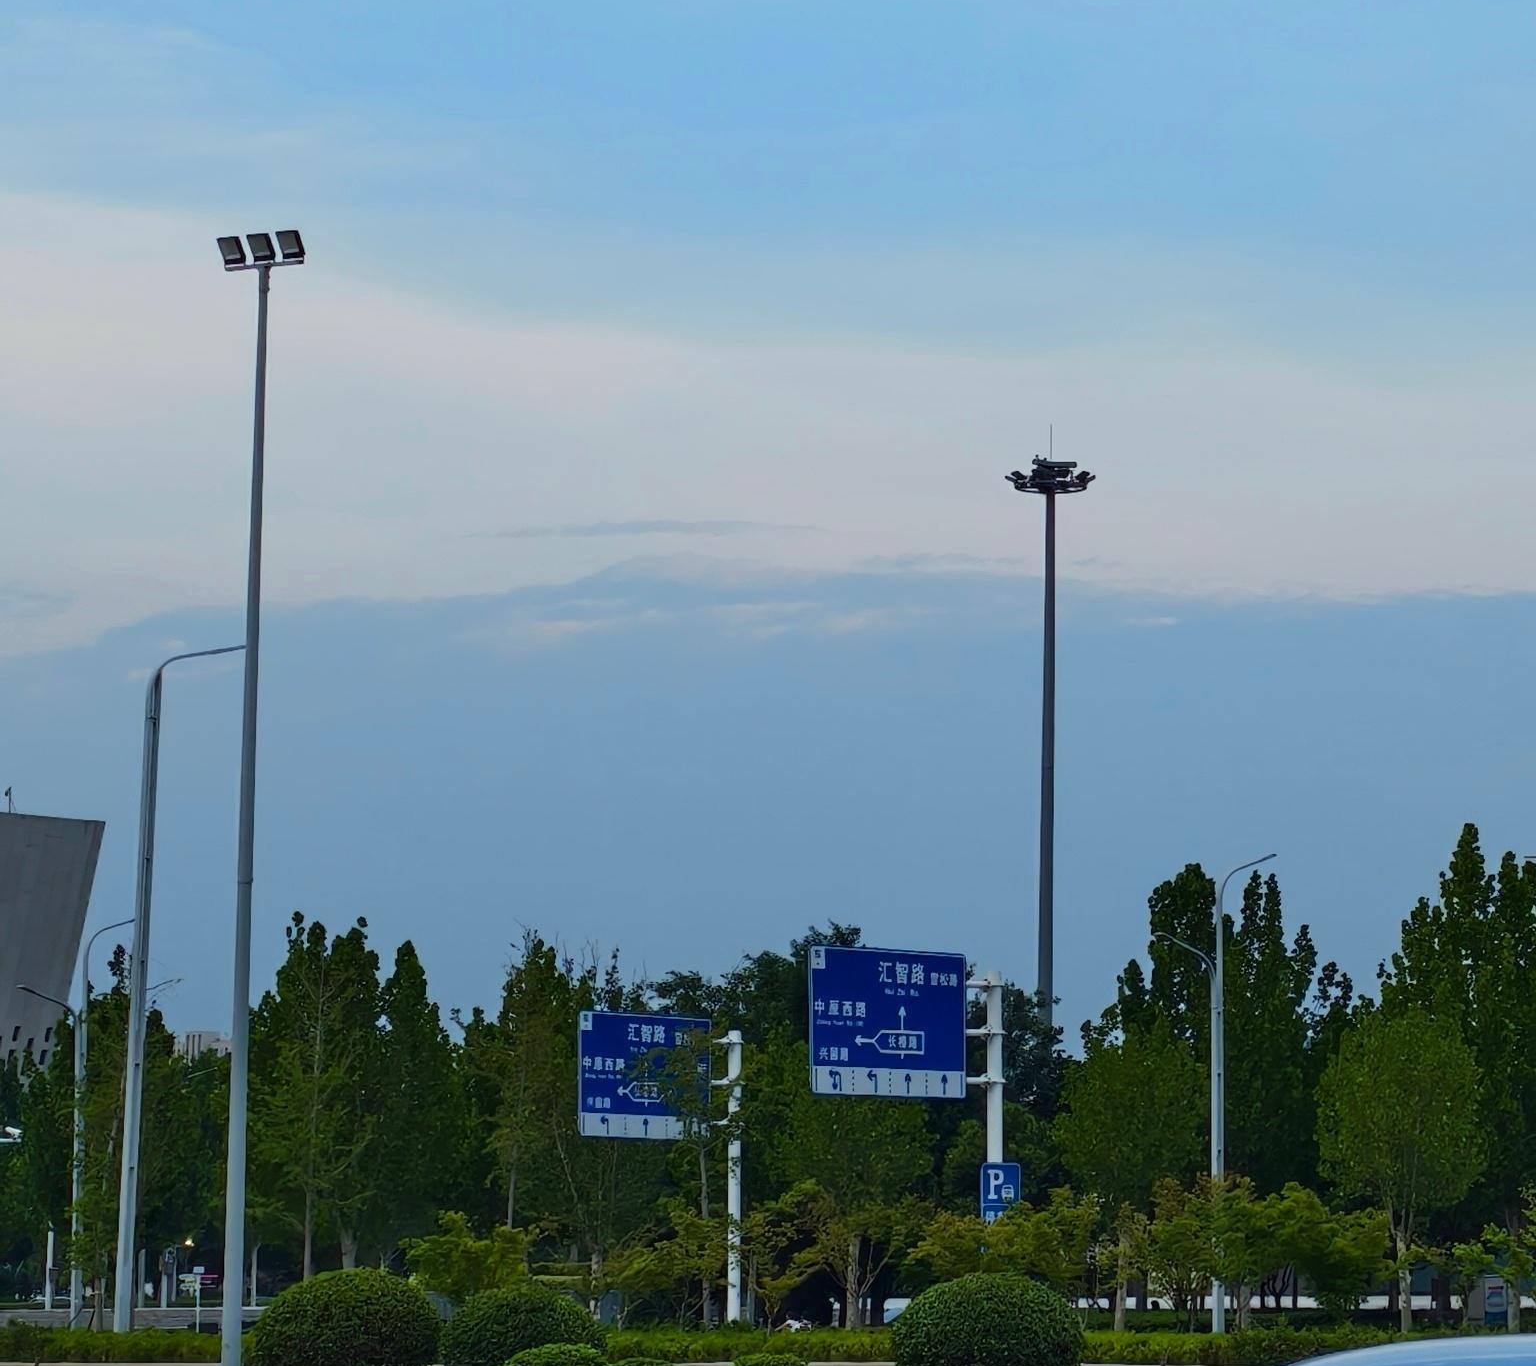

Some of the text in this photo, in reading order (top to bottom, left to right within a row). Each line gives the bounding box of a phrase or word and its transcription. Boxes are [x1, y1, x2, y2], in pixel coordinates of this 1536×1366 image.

[878, 961, 924, 985] 汇智路
[815, 998, 866, 1018] 中原西路
[628, 1023, 665, 1043] 汇智路
[987, 1169, 1004, 1200] P
